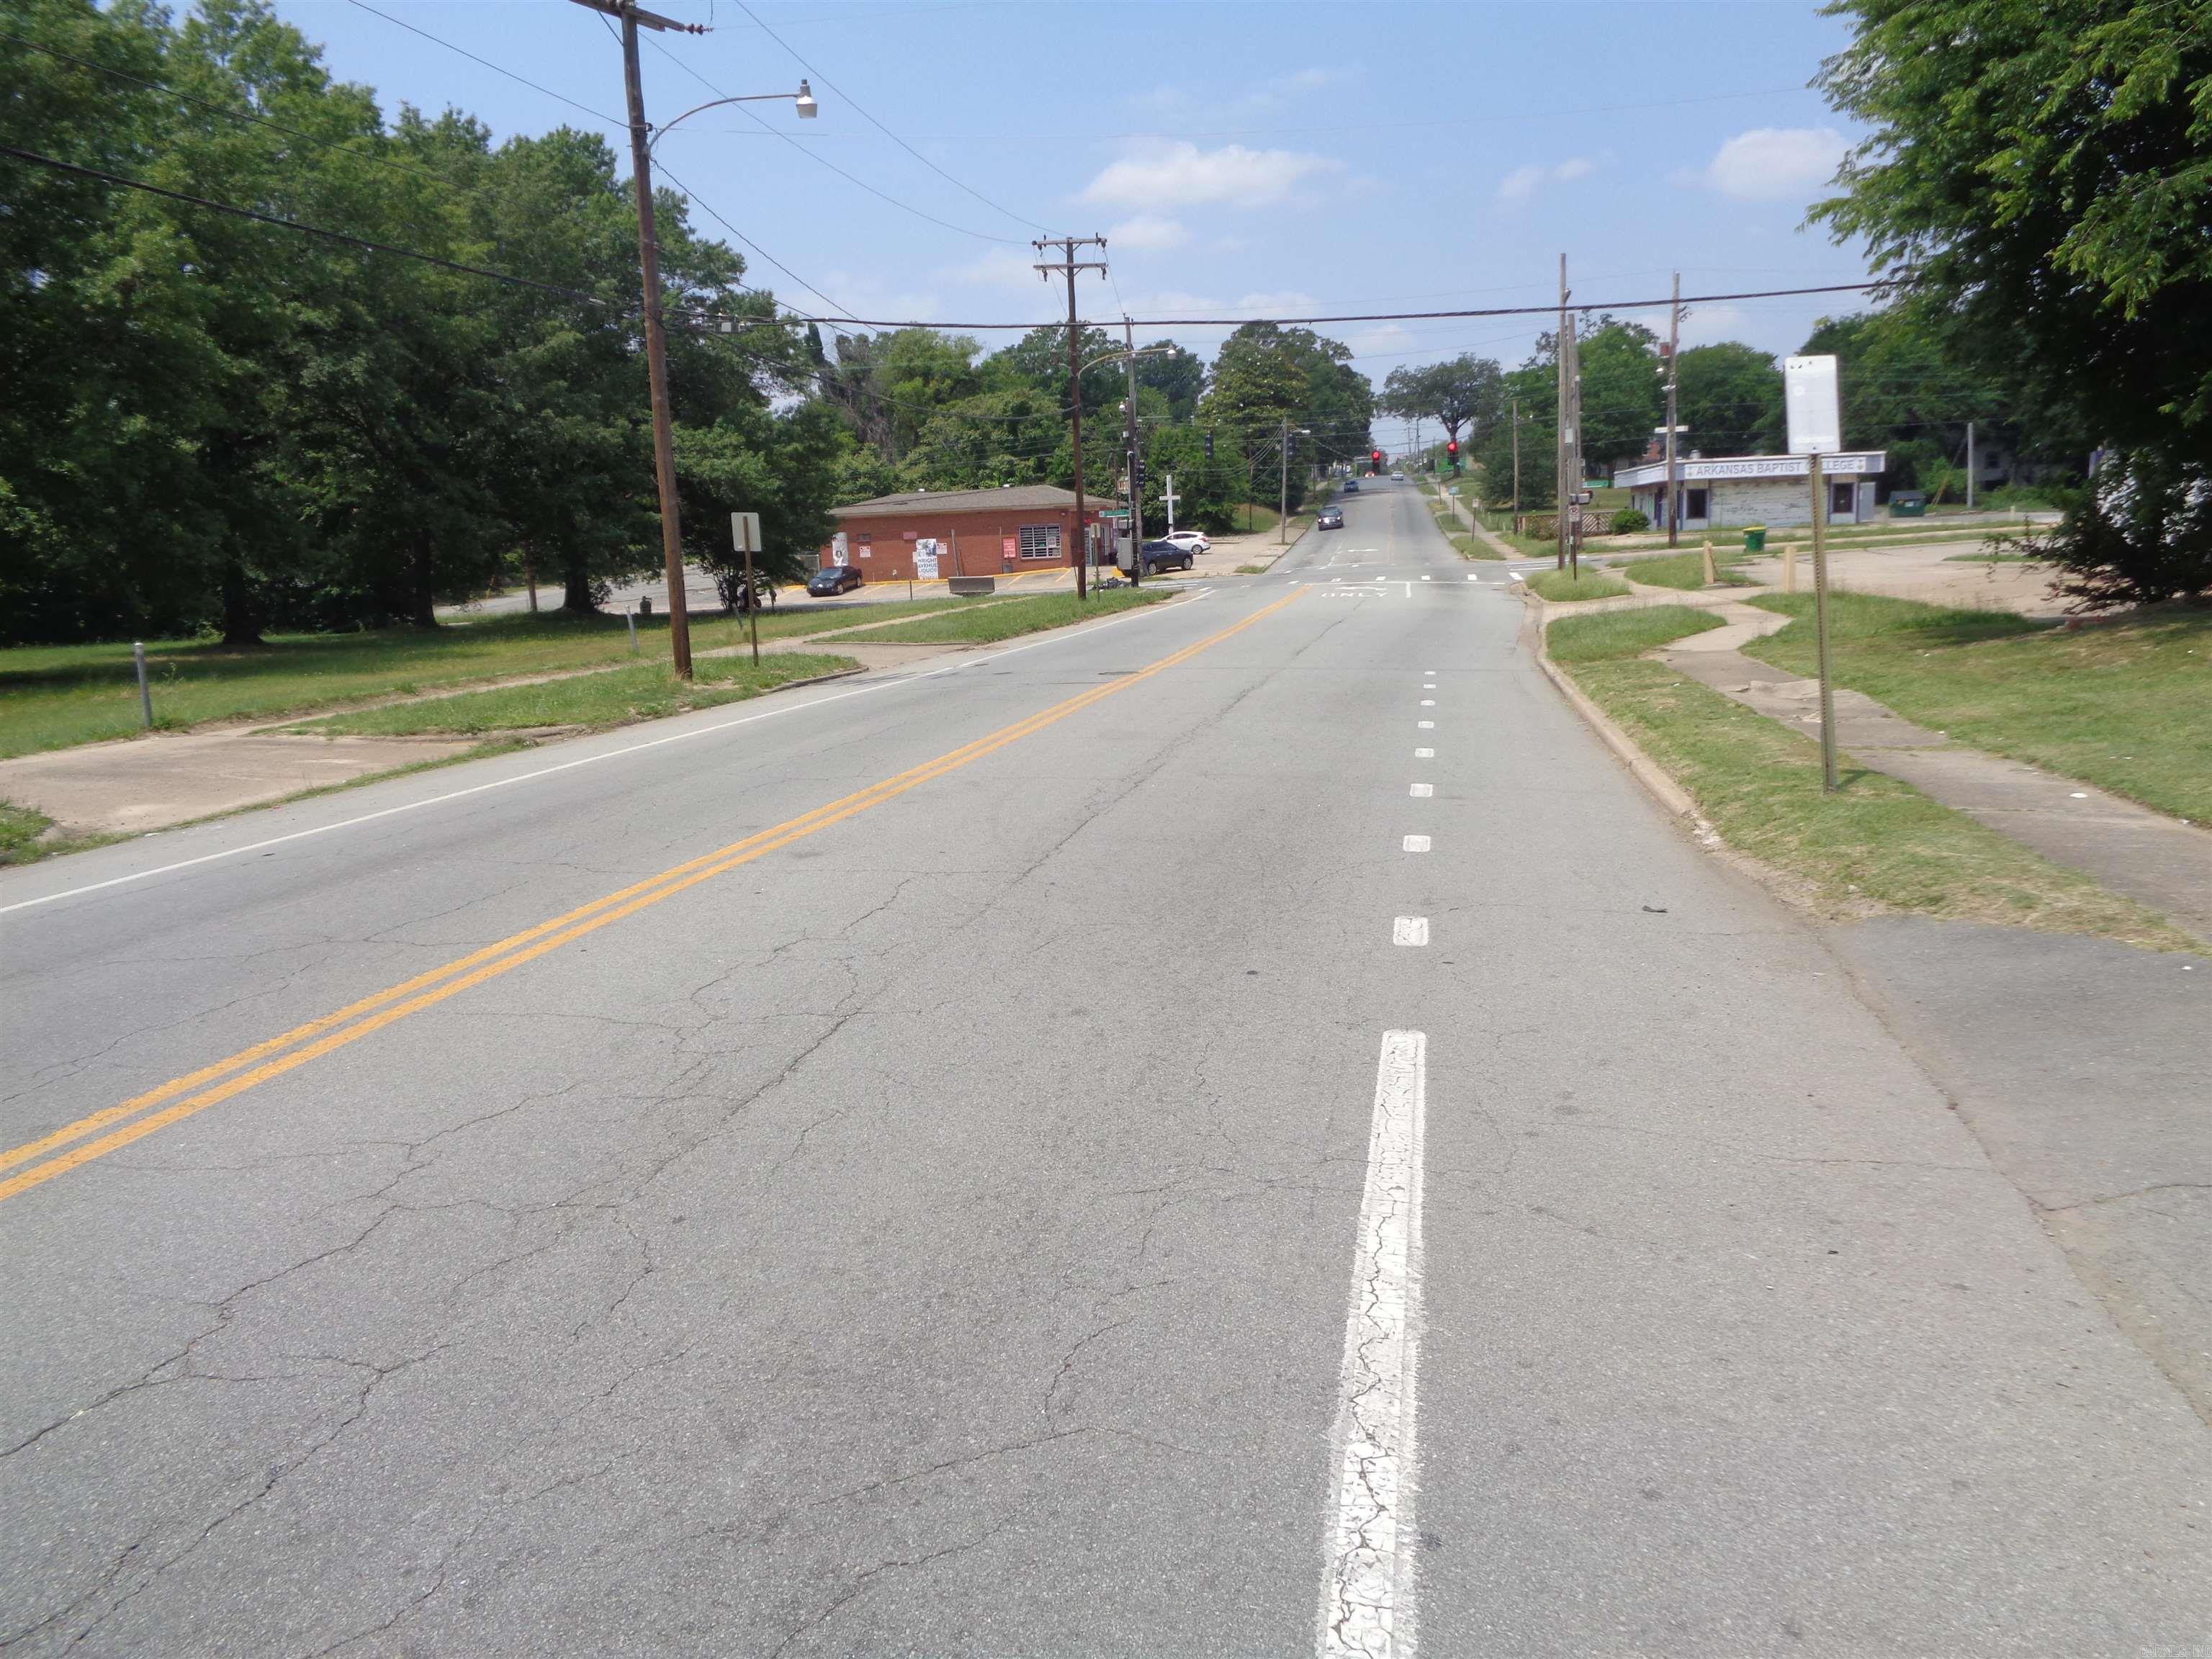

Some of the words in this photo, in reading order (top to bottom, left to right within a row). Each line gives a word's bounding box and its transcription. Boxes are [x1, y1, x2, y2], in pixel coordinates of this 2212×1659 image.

[1696, 464, 1755, 475] ARKANSAS
[1757, 462, 1801, 473] BAPTIST
[1804, 460, 1854, 472] CLLEGE
